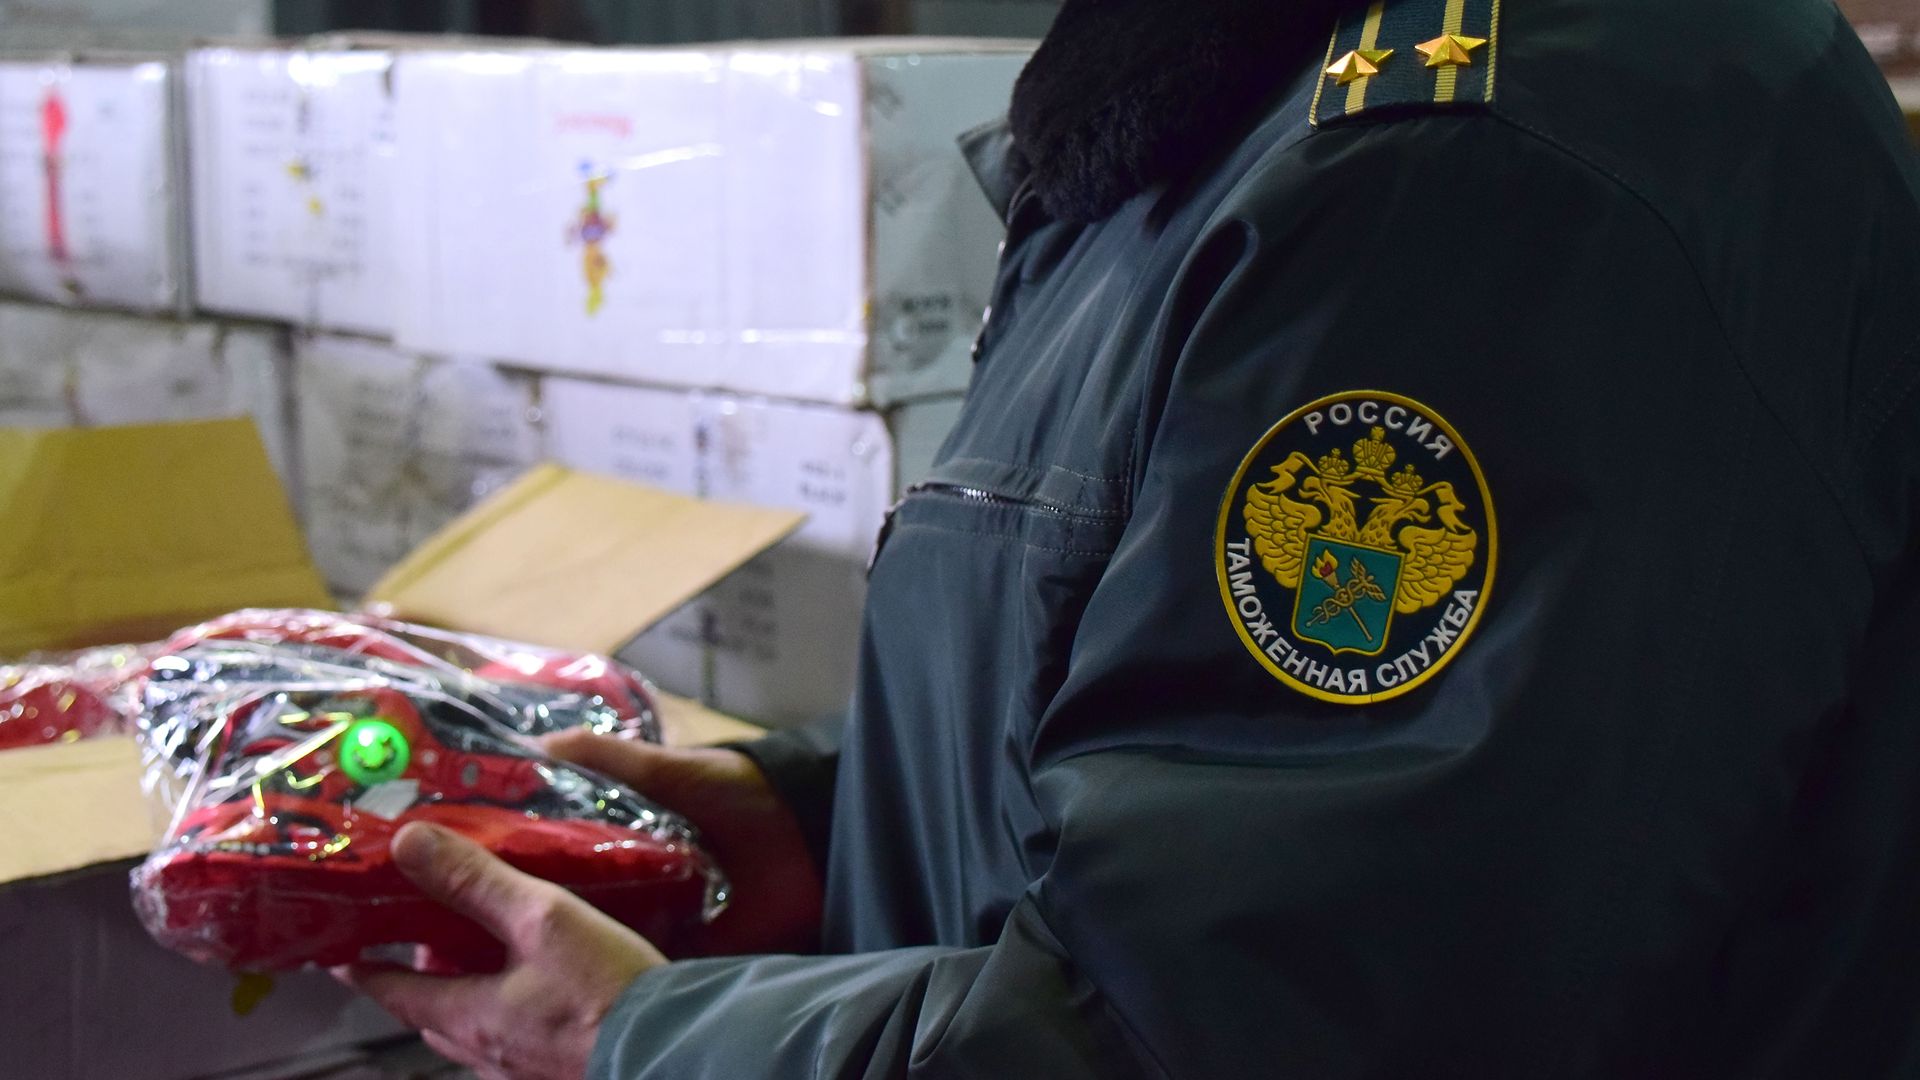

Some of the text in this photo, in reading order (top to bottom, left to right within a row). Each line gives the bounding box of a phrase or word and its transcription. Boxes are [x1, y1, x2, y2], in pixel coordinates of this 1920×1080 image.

[1303, 401, 1455, 461] РОССИЯ
[1226, 537, 1479, 693] ТАМОЖЕННАЯ СЛУЖБА
